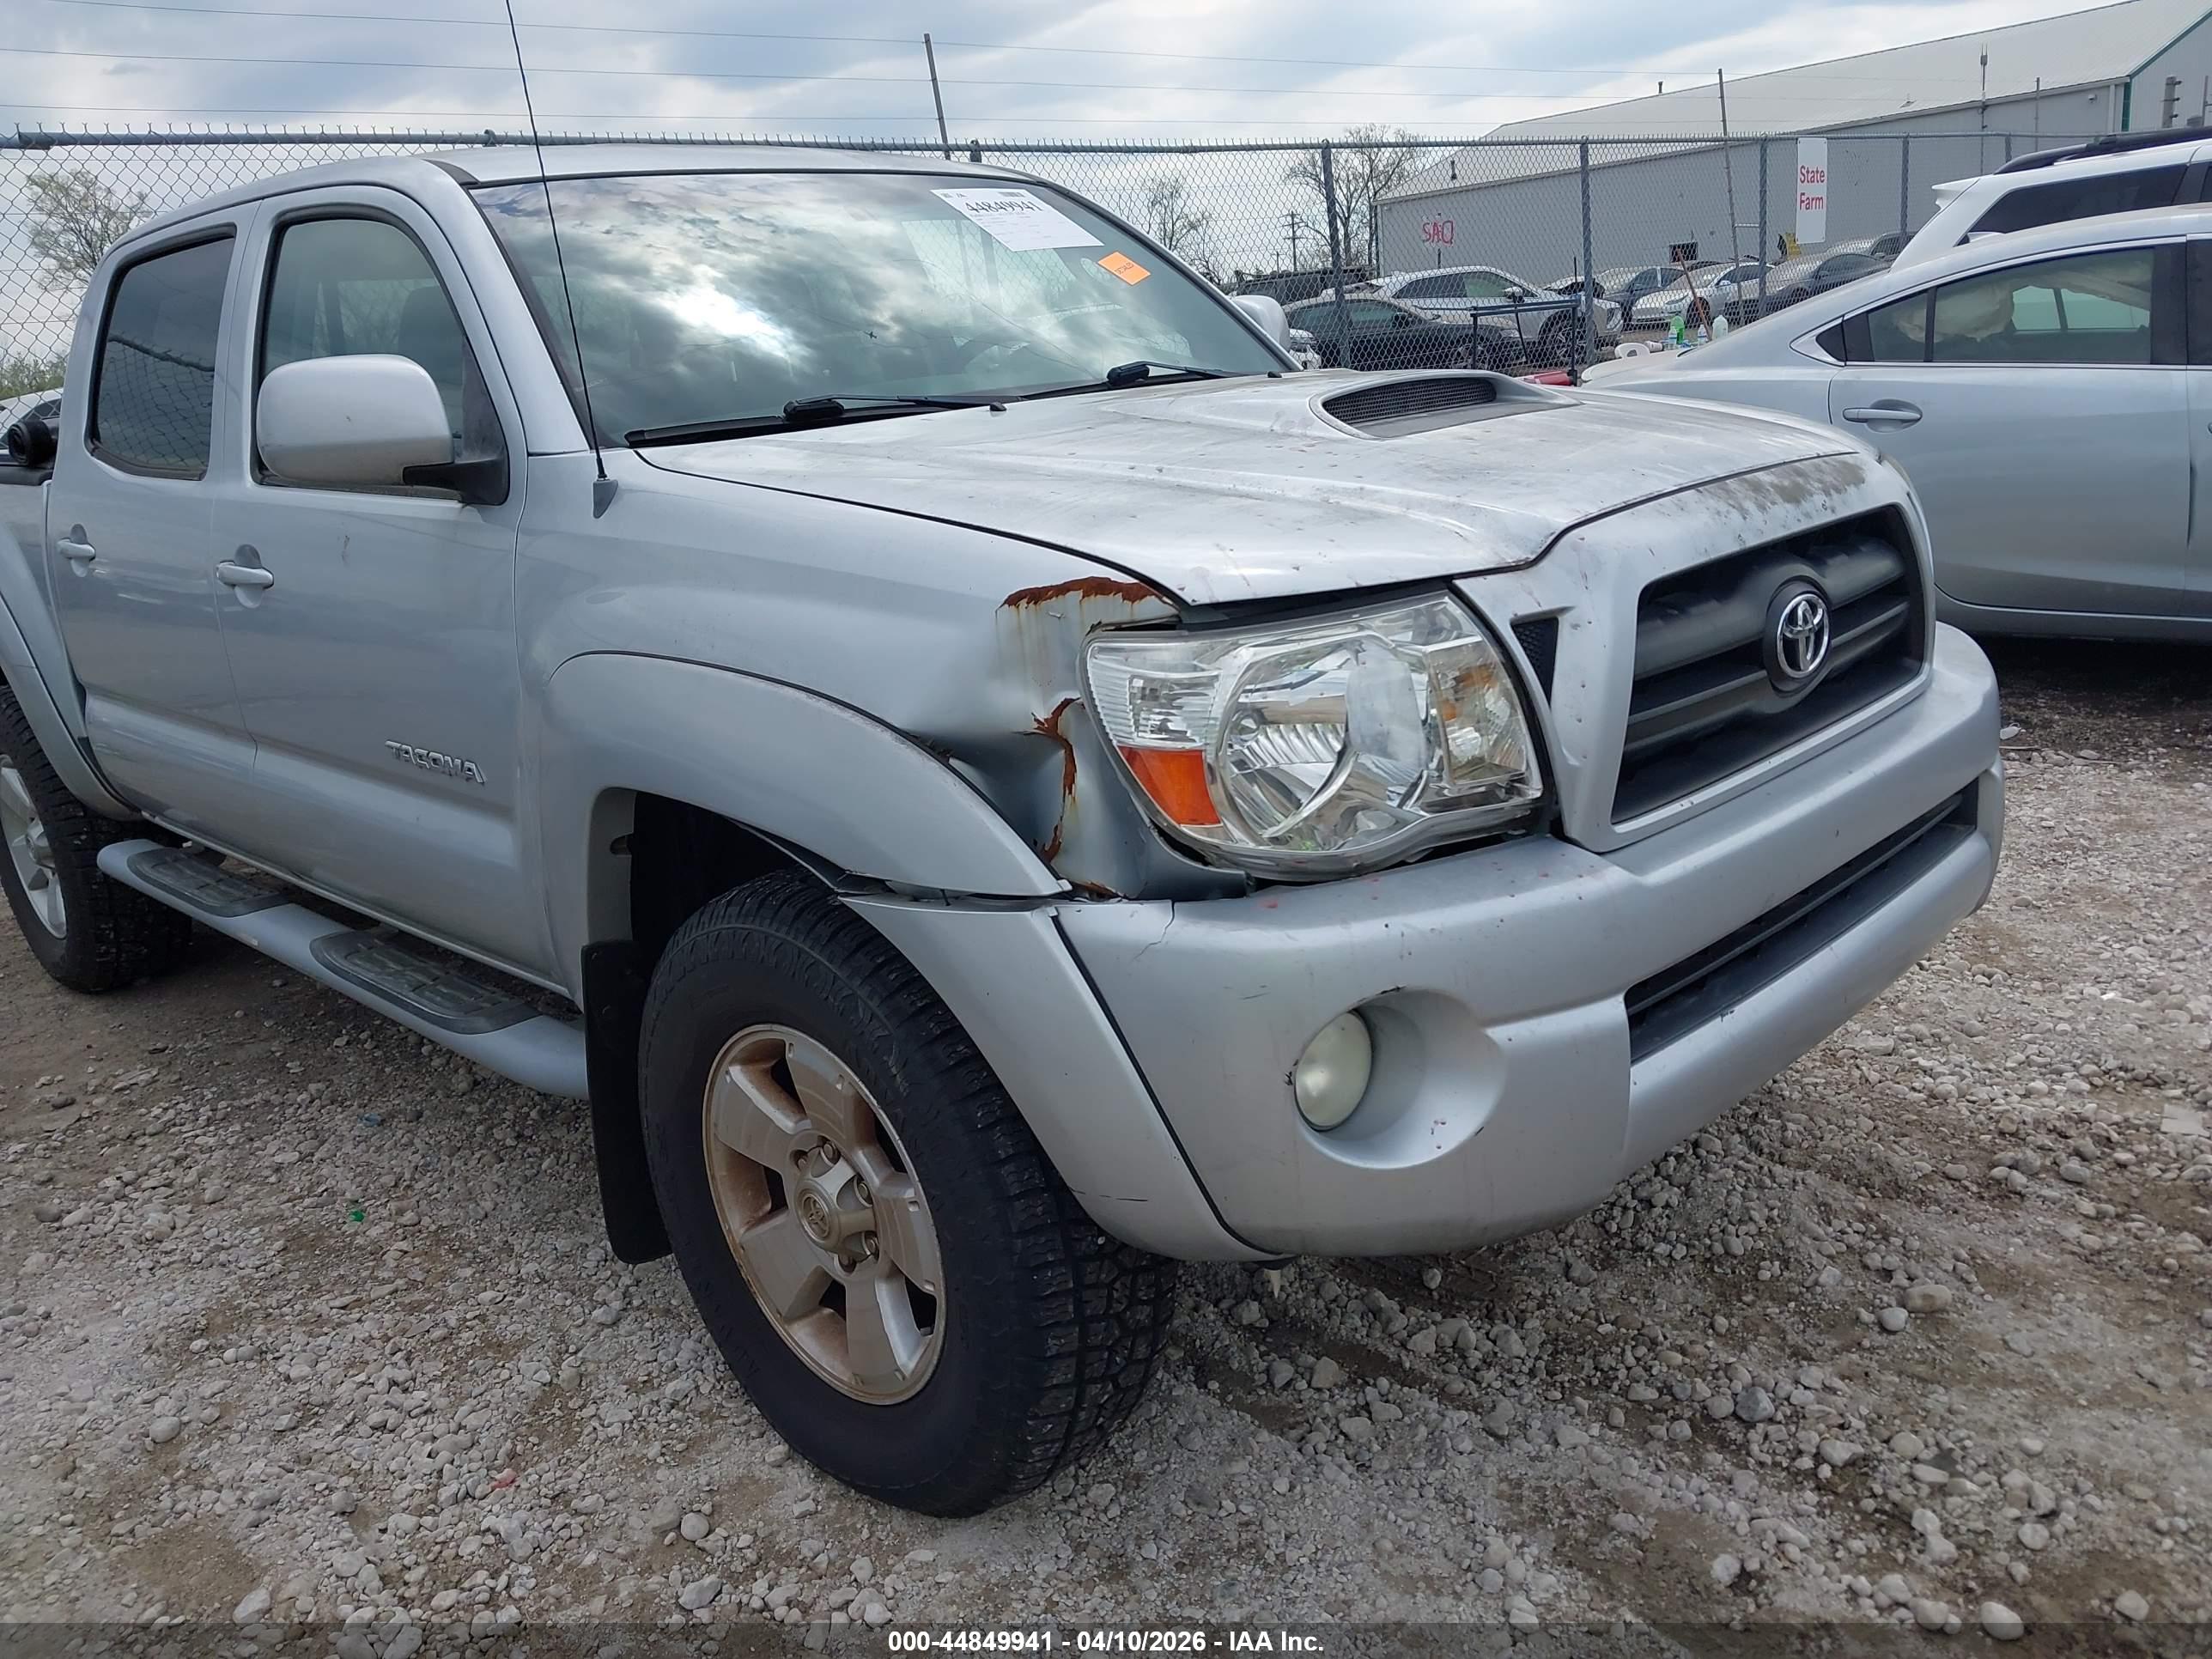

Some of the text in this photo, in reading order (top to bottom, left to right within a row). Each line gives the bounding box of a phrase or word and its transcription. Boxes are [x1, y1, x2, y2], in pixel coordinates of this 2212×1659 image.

[1800, 164, 1825, 184] State
[965, 200, 1043, 213] 44849941
[1800, 191, 1824, 210] Farm
[385, 739, 486, 784] TACOMA
